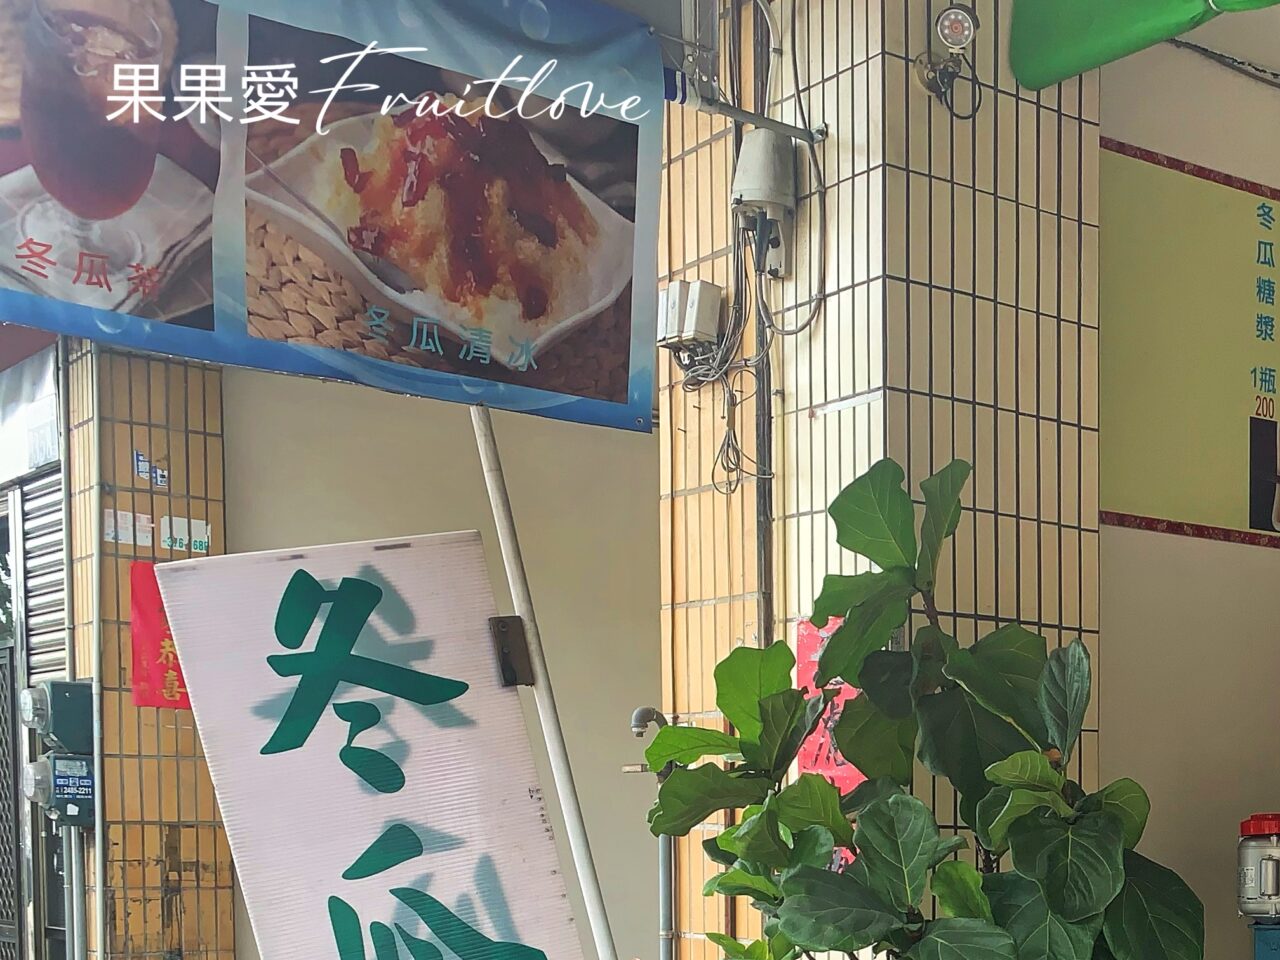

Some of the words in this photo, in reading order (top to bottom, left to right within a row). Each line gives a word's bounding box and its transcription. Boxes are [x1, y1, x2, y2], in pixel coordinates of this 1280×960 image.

[1256, 203, 1276, 342] 冬瓜糖漿
[366, 305, 538, 373] 冬瓜清冰
[1251, 367, 1276, 394] 1瓶
[1255, 396, 1275, 419] 200
